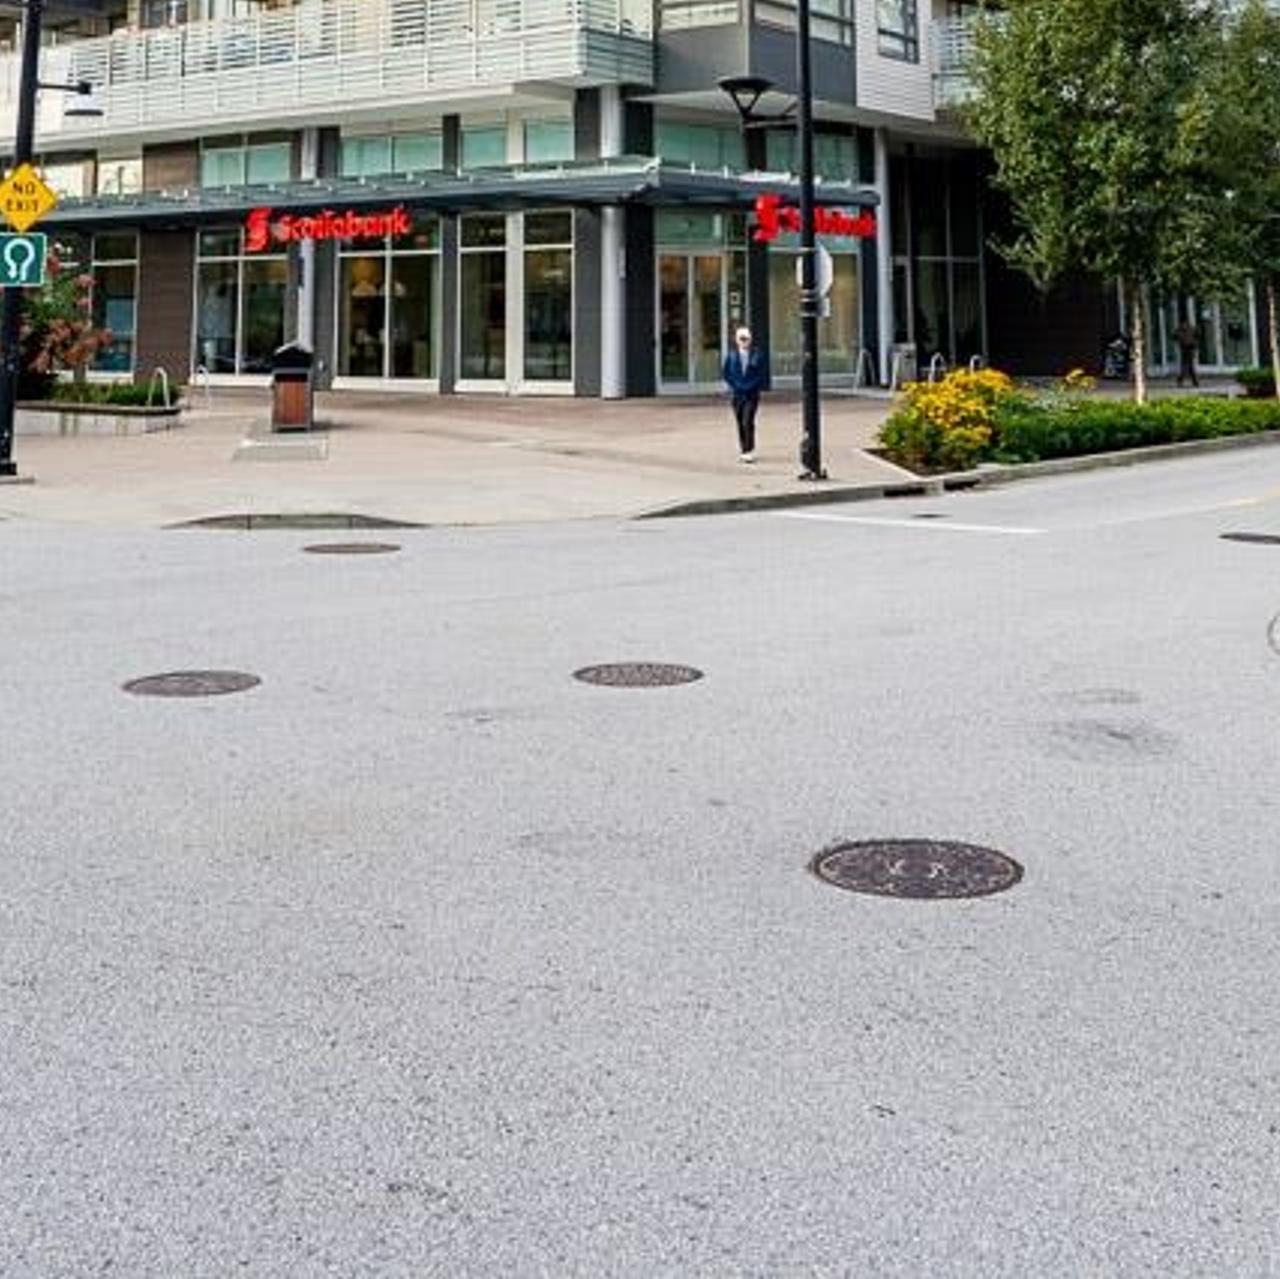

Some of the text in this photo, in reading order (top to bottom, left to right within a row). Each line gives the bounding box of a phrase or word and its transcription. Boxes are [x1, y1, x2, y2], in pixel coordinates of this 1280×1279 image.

[13, 181, 36, 195] NO
[6, 198, 39, 213] EXIT
[276, 206, 411, 240] Scotiabank
